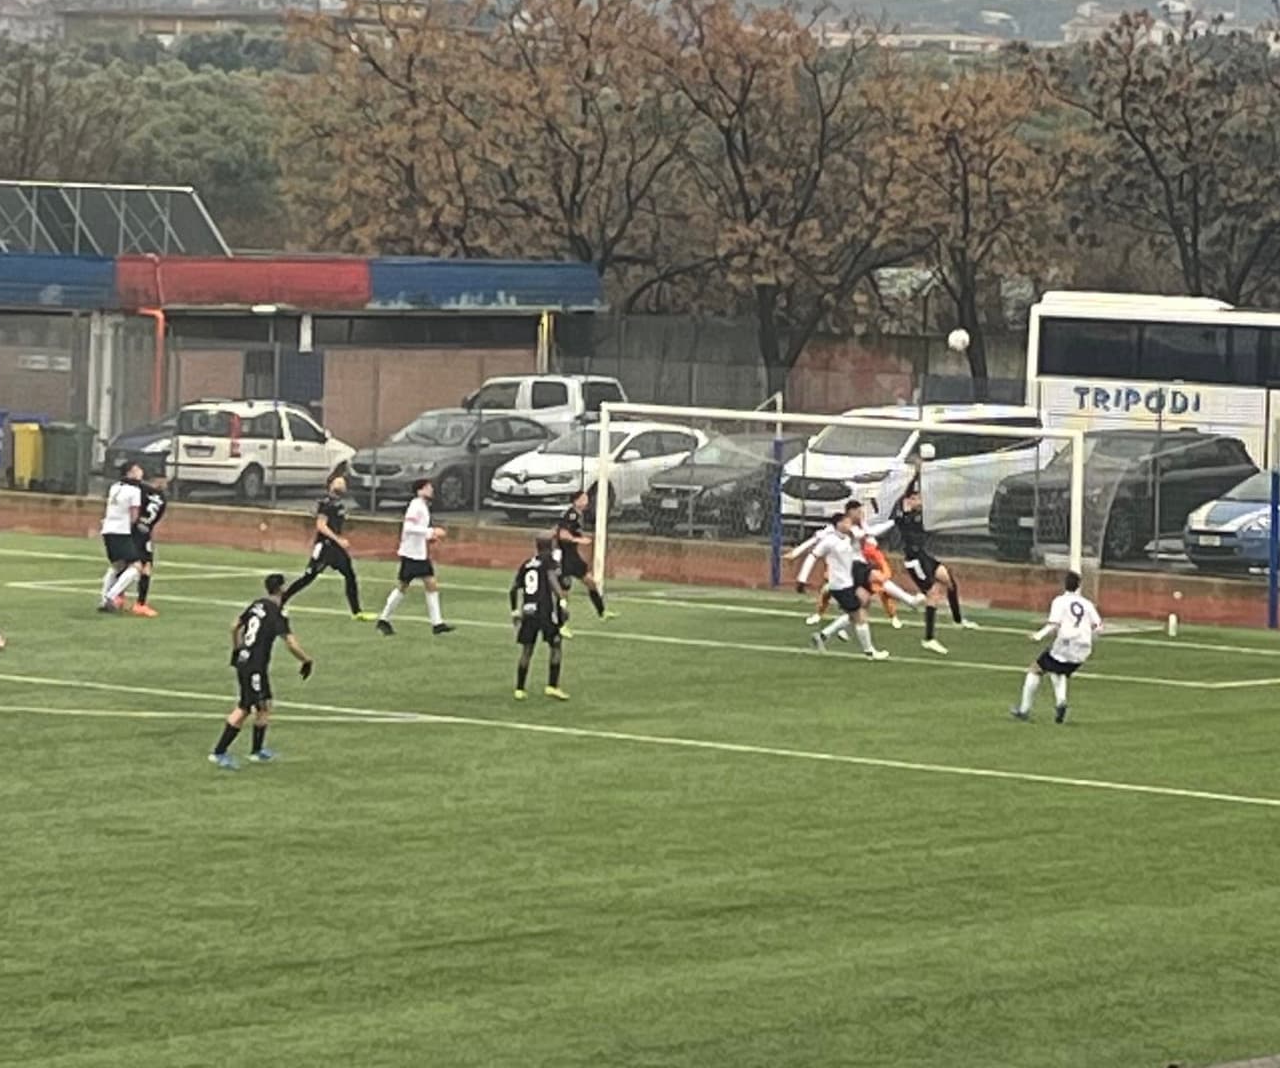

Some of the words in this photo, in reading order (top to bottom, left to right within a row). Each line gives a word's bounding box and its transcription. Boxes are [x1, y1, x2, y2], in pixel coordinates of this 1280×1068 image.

[1073, 386, 1201, 413] TRIPODI
[140, 502, 160, 525] 5
[1070, 601, 1084, 628] 9
[244, 615, 260, 647] 8
